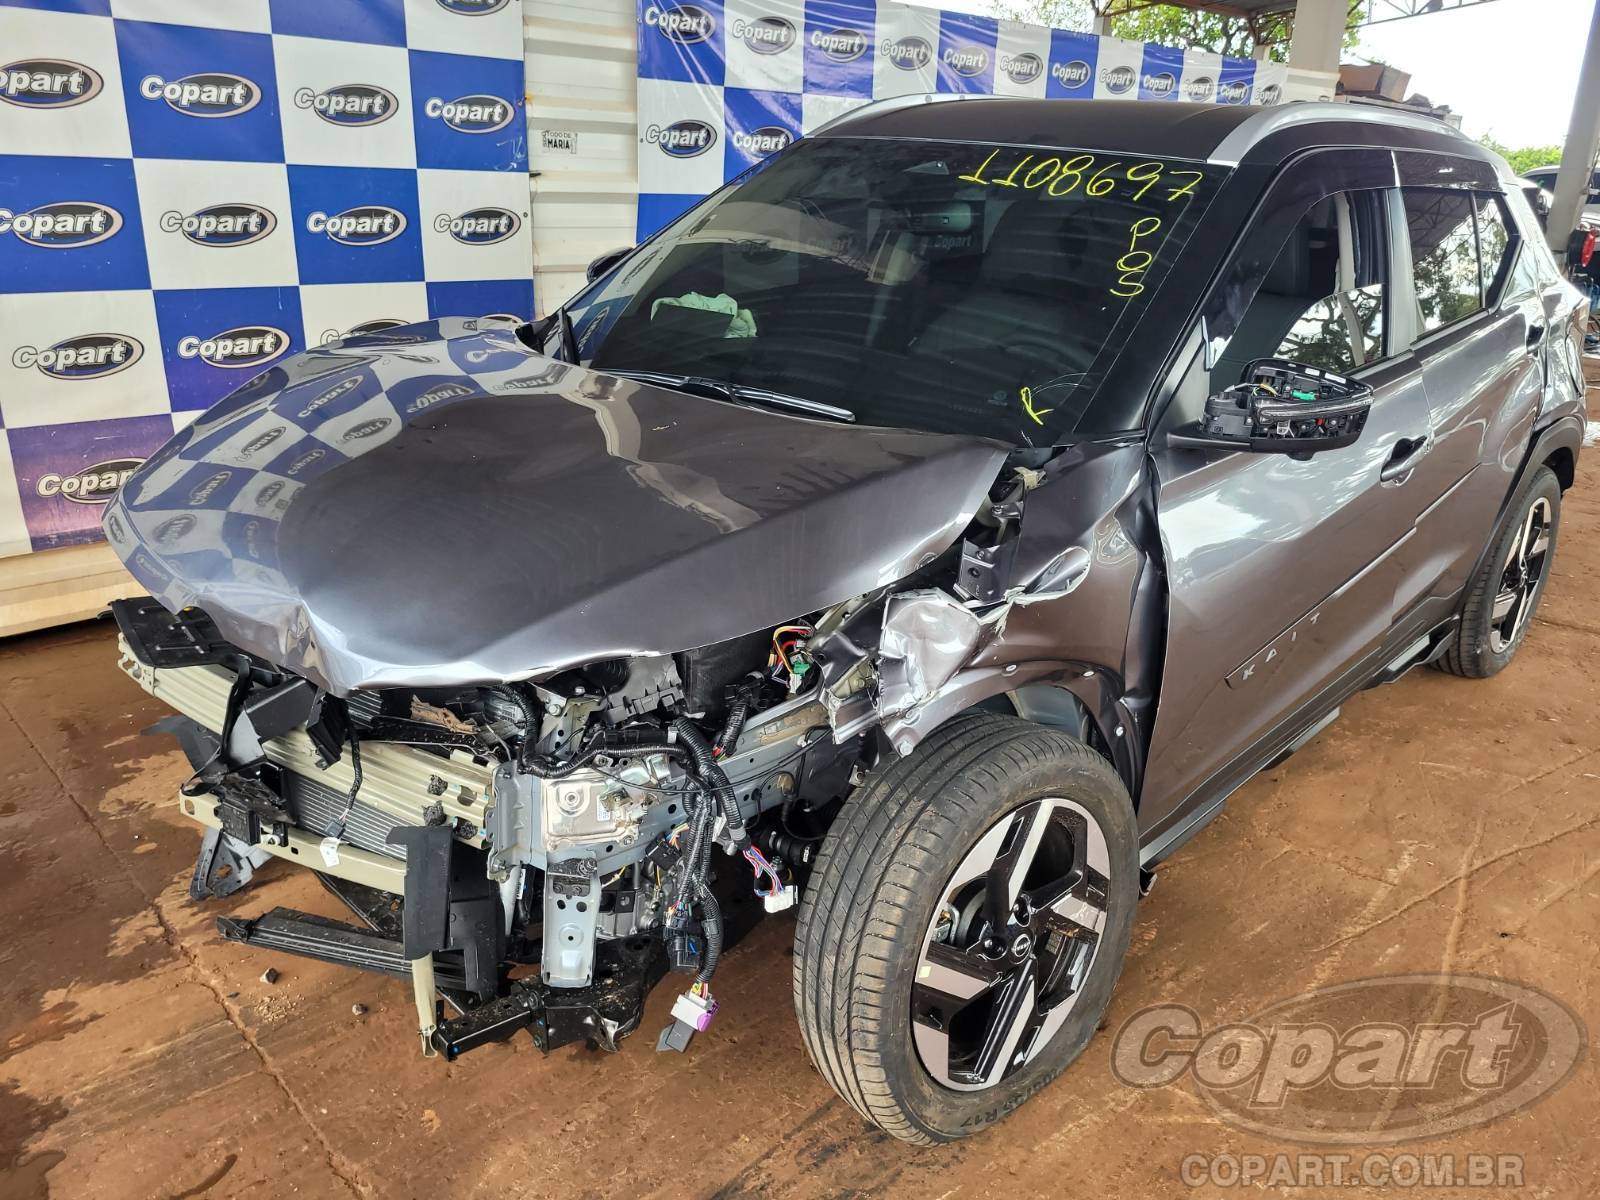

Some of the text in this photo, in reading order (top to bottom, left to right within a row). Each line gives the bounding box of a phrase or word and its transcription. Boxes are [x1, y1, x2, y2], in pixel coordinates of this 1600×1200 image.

[644, 6, 708, 35] Copart
[732, 19, 788, 44] Copart
[811, 30, 860, 54] Copart
[881, 39, 926, 61] Copart
[943, 48, 983, 68] Copart
[1000, 56, 1037, 75] Copart
[1052, 63, 1087, 80] Copart
[1100, 69, 1132, 86] Copart
[1144, 74, 1173, 91] Copart
[140, 76, 248, 106] Copart
[1183, 79, 1210, 96] Copart
[1222, 83, 1246, 98] Copart
[295, 88, 385, 115] Copart
[425, 97, 506, 123] Copart
[547, 139, 570, 150] MARIA
[645, 124, 708, 147] Copart
[733, 131, 786, 154] Copart
[958, 149, 1203, 201] 1108697
[0, 207, 105, 239] Copart
[160, 210, 263, 237] Copart
[308, 211, 396, 236] Copart
[434, 213, 508, 236] Copart
[12, 341, 128, 372] Copart
[178, 336, 278, 360] Copart
[37, 468, 134, 499] Copar
